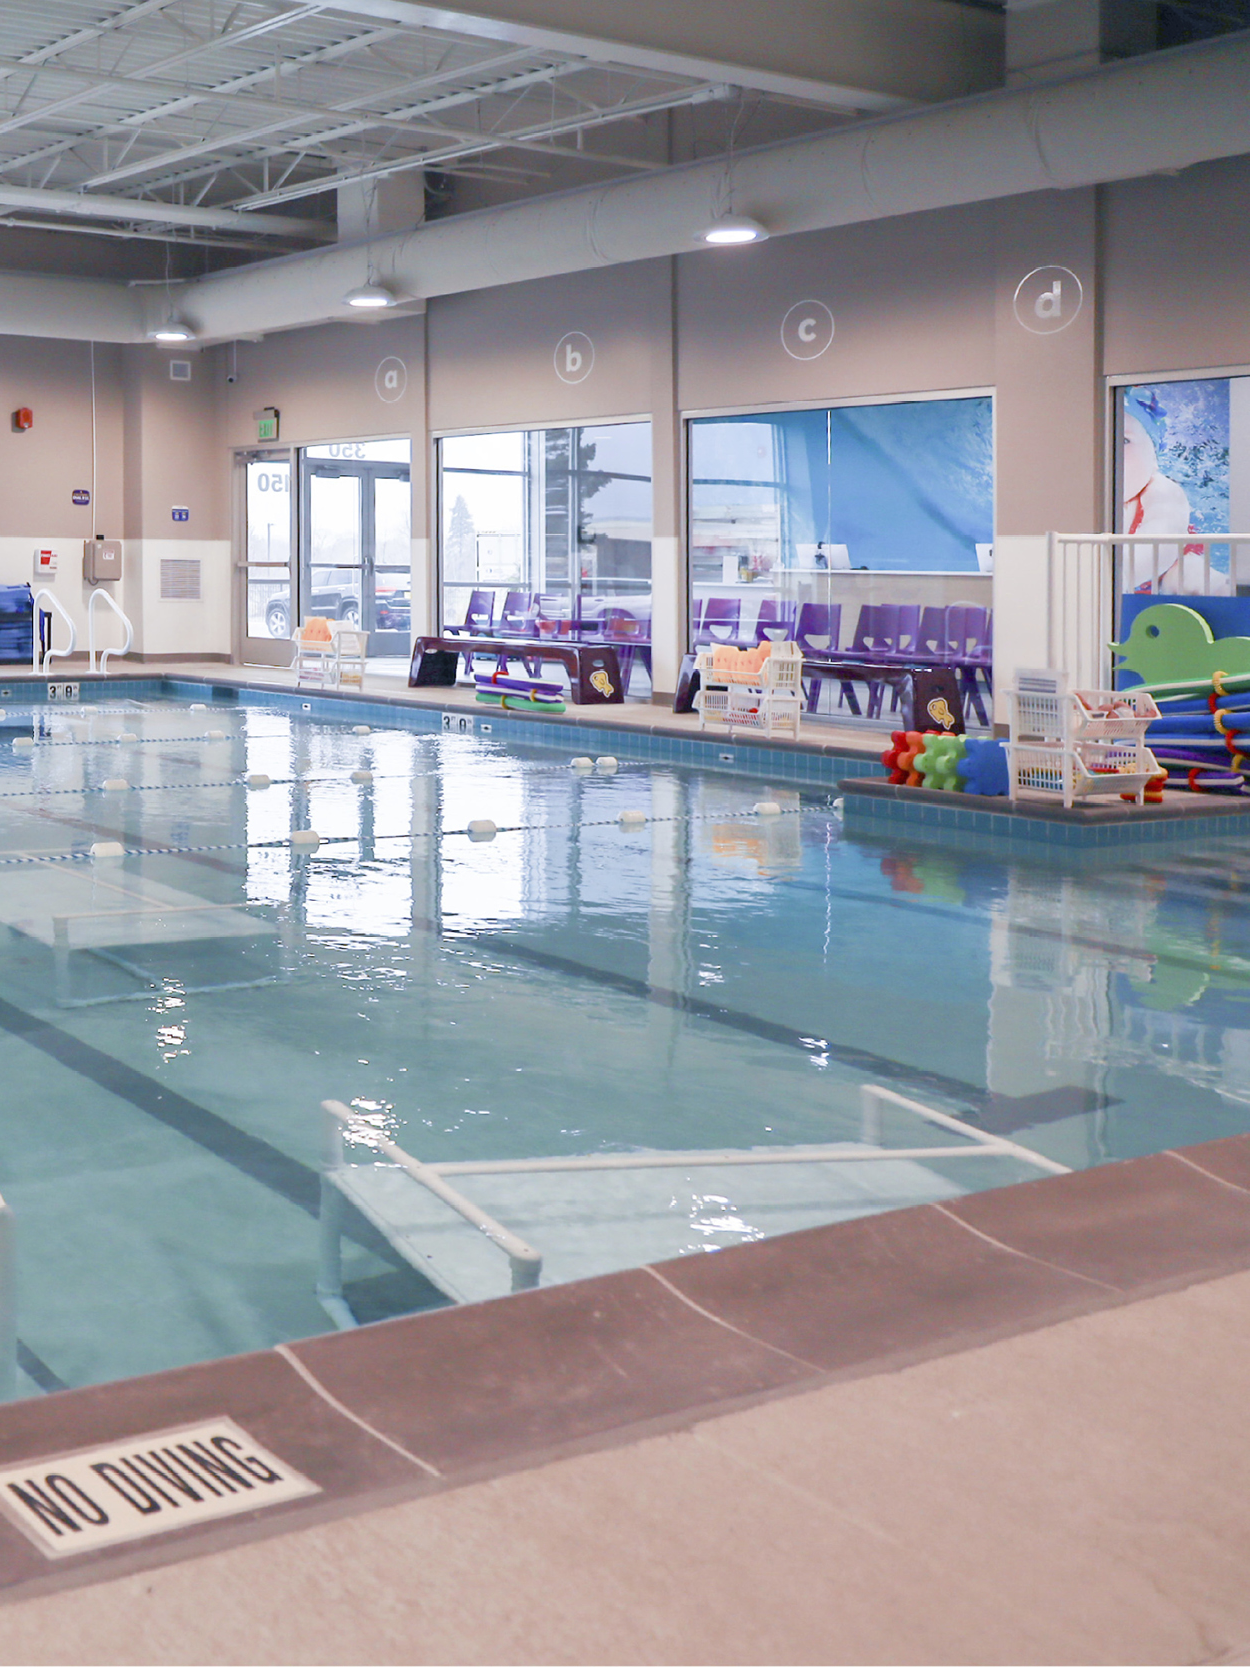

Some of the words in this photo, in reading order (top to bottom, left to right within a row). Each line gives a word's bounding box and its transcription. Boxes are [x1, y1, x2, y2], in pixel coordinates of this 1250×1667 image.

[1034, 280, 1061, 318] d
[798, 318, 817, 342] c
[566, 344, 582, 372] b
[385, 369, 398, 389] a
[7, 1474, 109, 1537] NO
[89, 1436, 284, 1516] DIVING
